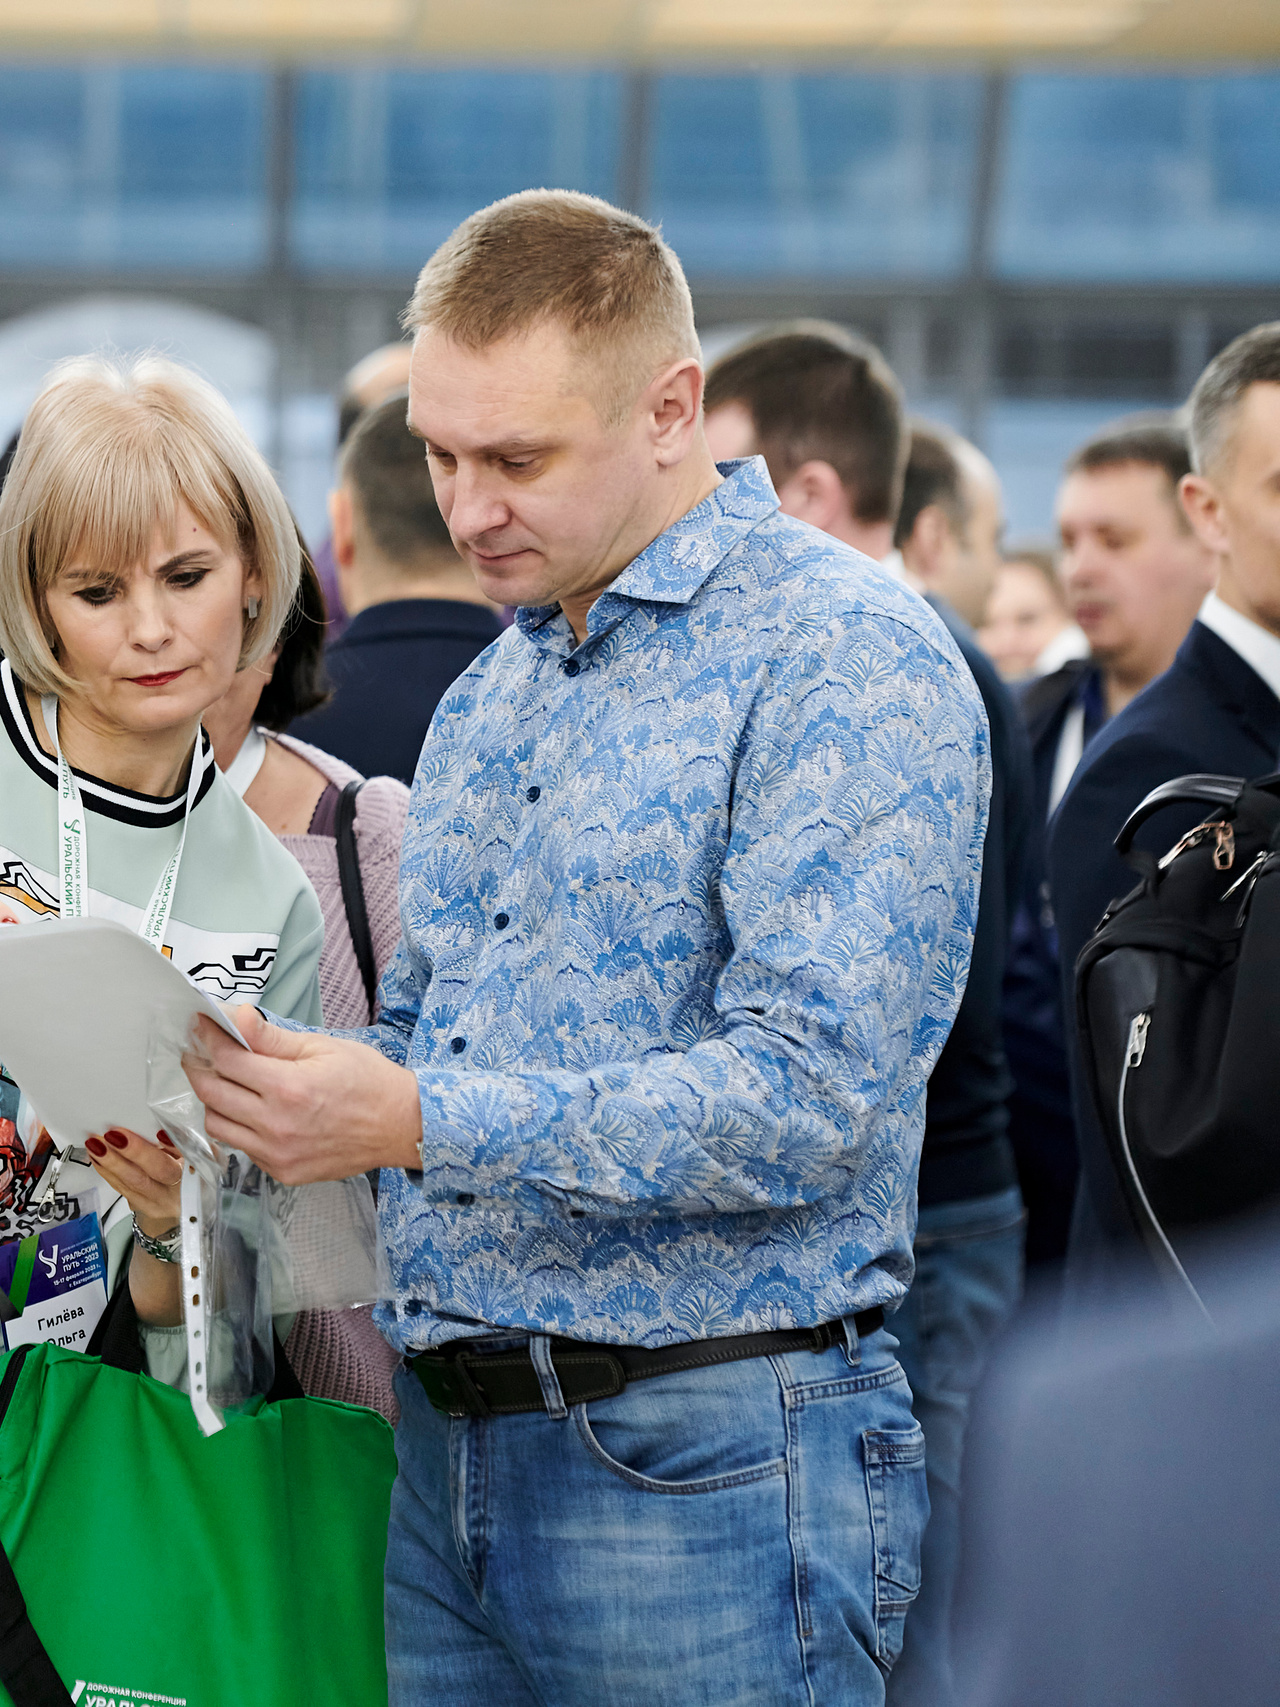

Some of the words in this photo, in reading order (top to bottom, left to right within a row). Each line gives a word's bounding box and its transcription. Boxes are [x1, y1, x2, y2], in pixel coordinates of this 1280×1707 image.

[64, 836, 74, 905] УРАЛЬСКИЙ
[145, 898, 159, 937] ДОРОЖНАЯ
[152, 875, 173, 938] УРАЛЬСКИЙ
[61, 1242, 98, 1264] УРАЛЬСКИЙ
[62, 1260, 81, 1273] ПУТЬ
[84, 1251, 100, 1264] 2023
[37, 1306, 85, 1331] Гилёва
[86, 1682, 130, 1697] ДОРОЖНАЯ
[131, 1689, 187, 1707] КОНФЕРЕНЦИЯ
